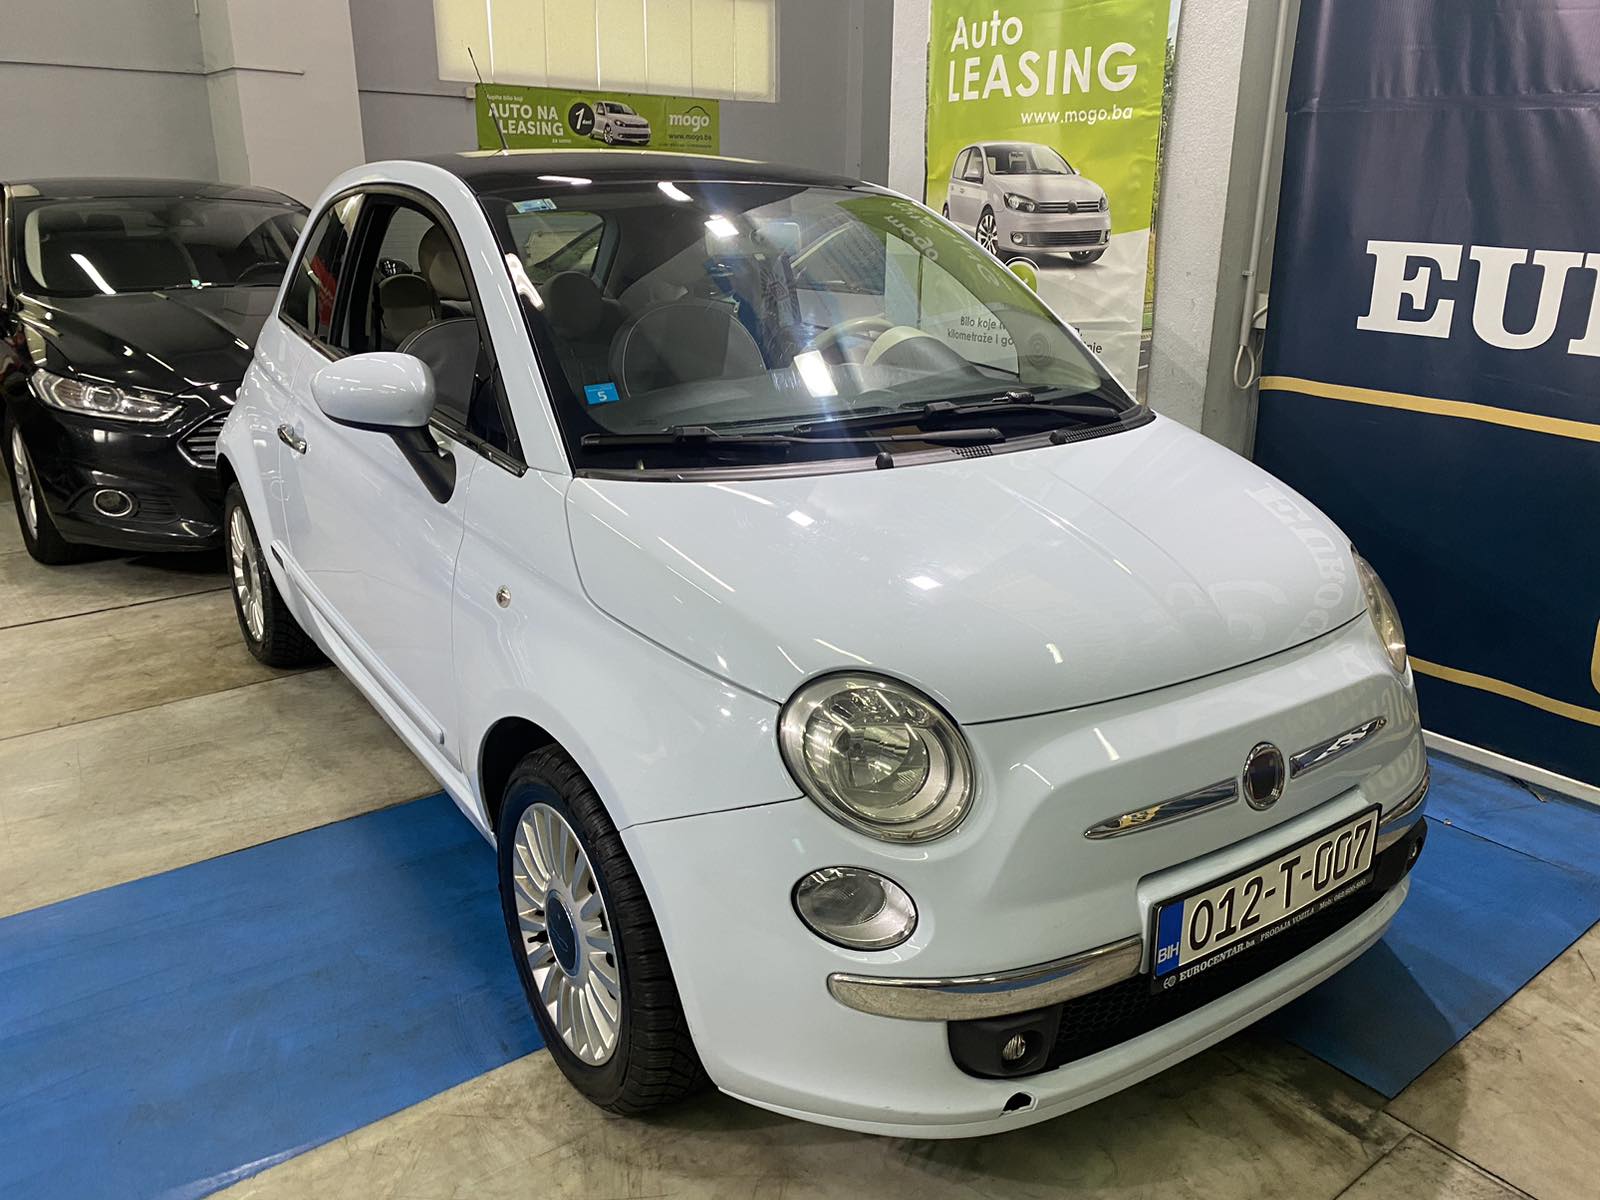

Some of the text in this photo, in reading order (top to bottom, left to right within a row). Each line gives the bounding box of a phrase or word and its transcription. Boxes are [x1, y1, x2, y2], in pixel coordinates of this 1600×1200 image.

[951, 9, 1023, 53] Auto
[948, 41, 1137, 103] LEASING
[488, 102, 559, 121] AUTO NA
[1020, 104, 1134, 126] www.mogo.ba
[499, 119, 565, 137] LEASING
[669, 114, 710, 132] mogo
[977, 317, 997, 331] koje
[597, 391, 608, 402] 5
[1189, 818, 1372, 951] 012-T-007
[1157, 942, 1180, 964] BIH
[1179, 939, 1256, 982] EUROCENTAR.ba
